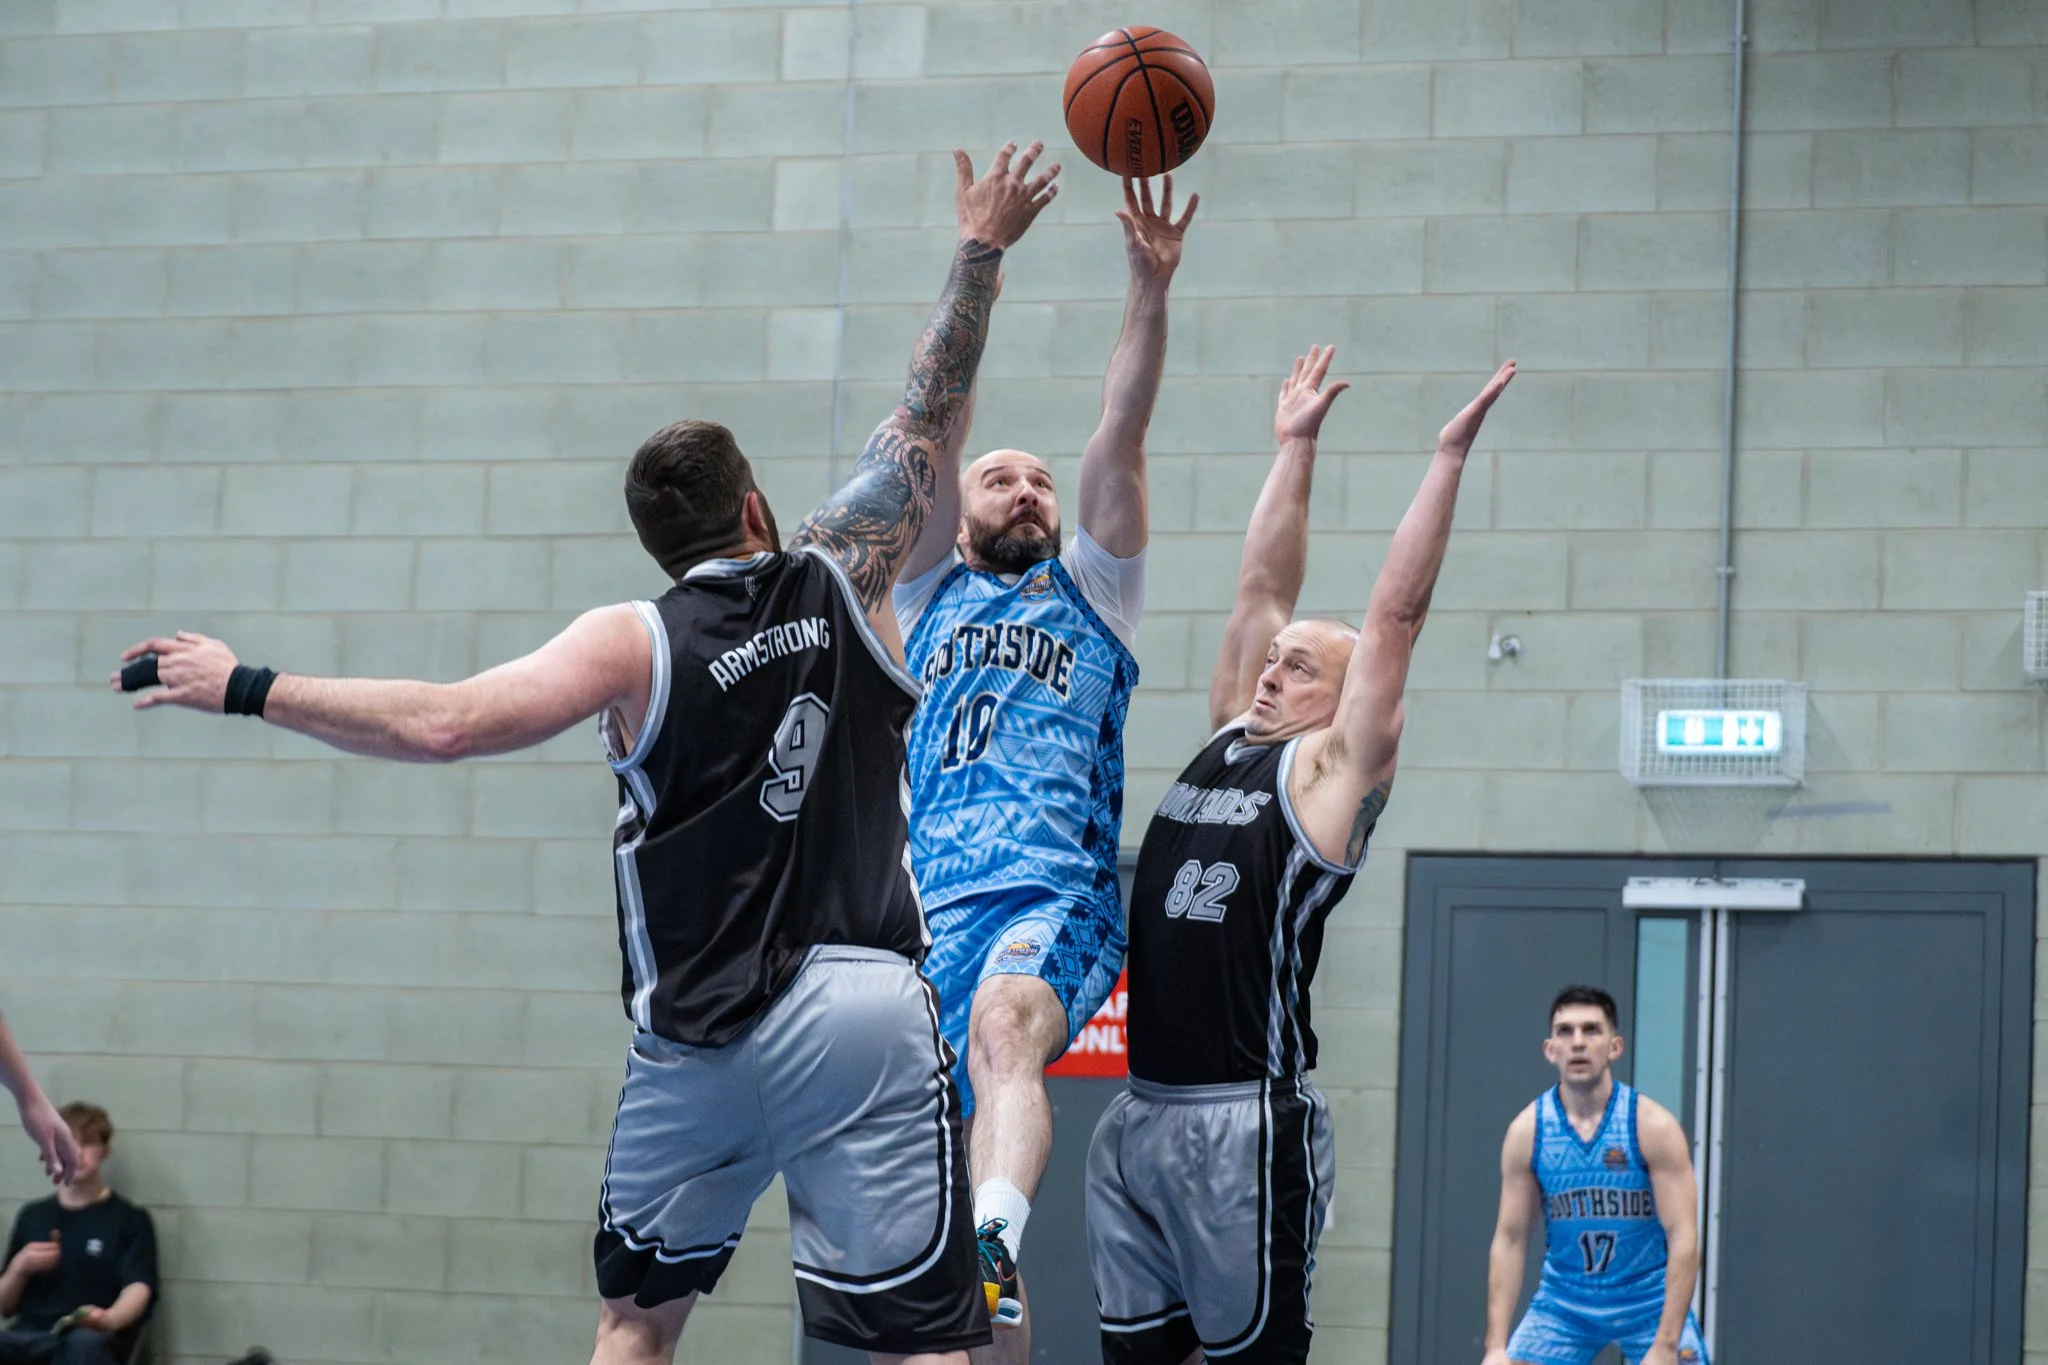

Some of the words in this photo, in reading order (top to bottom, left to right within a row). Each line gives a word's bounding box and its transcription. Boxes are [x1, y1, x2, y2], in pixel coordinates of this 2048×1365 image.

[708, 616, 830, 692] ARMSTRONG
[759, 692, 830, 823] 9
[941, 691, 1000, 774] 10
[1165, 859, 1240, 923] 82
[1067, 1024, 1127, 1055] ONL
[1578, 1231, 1618, 1275] 17
